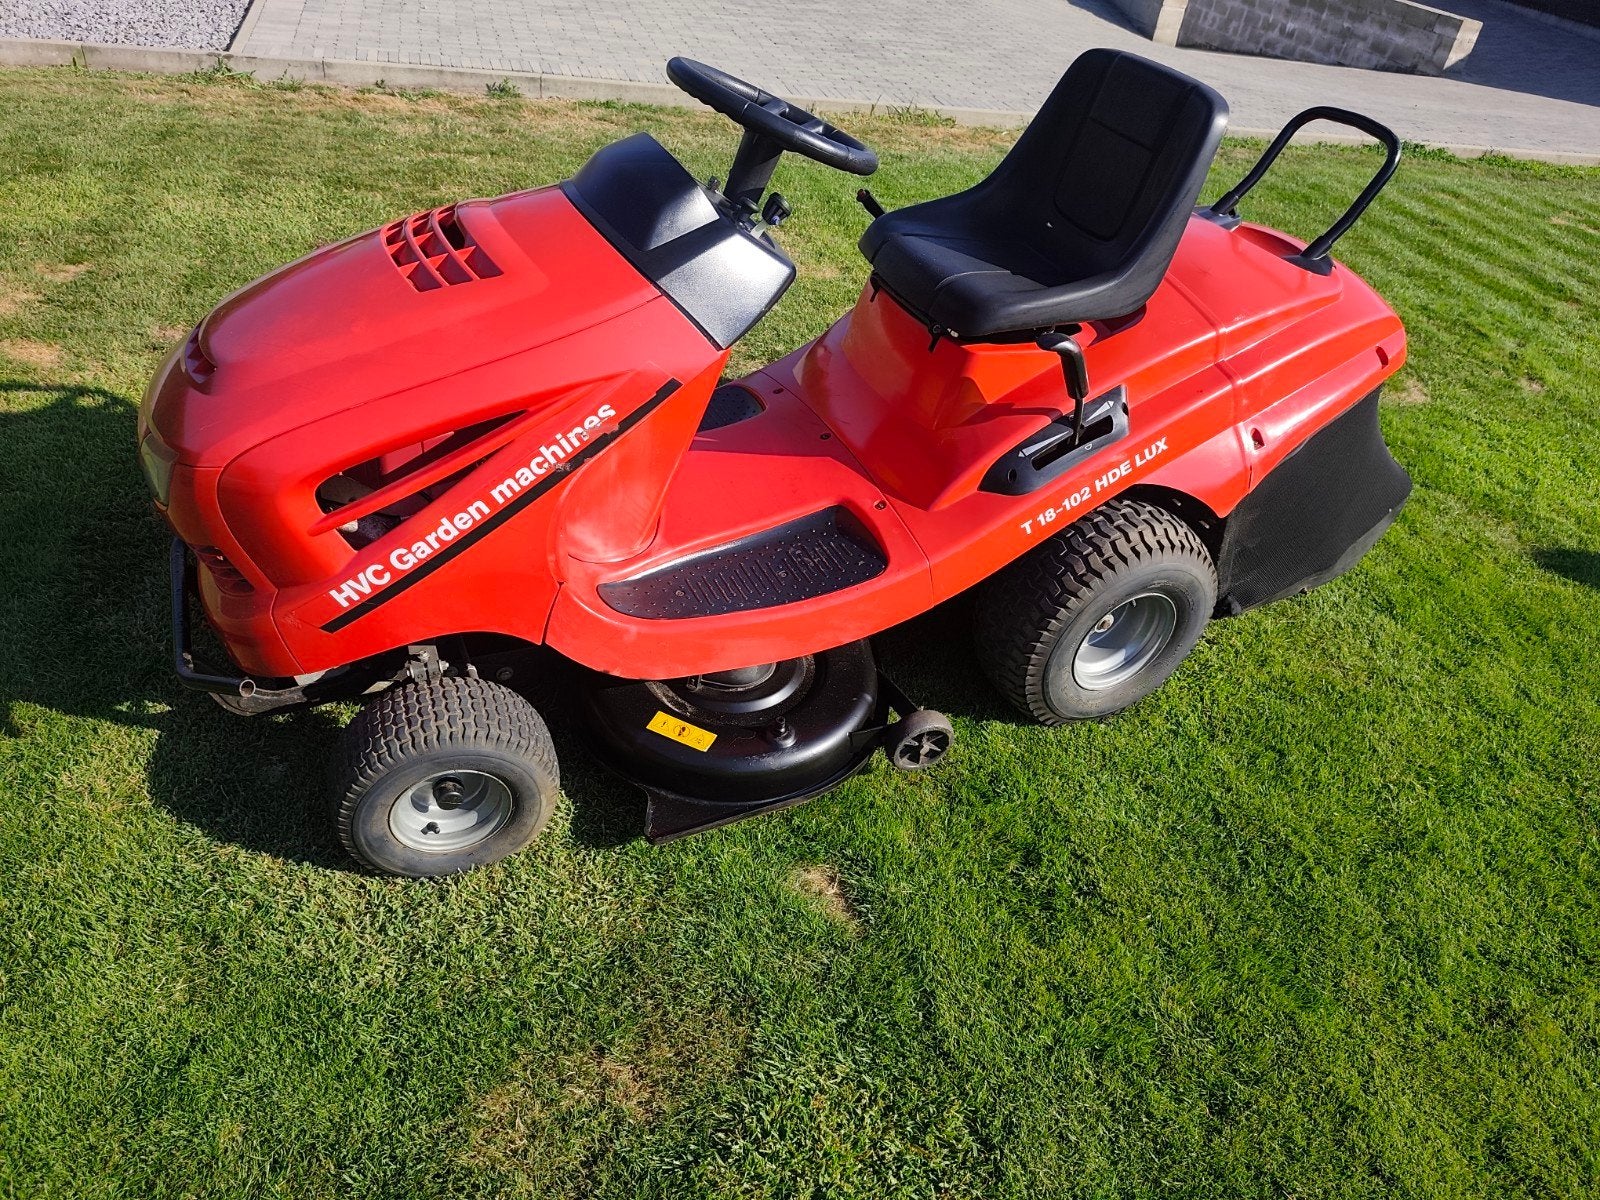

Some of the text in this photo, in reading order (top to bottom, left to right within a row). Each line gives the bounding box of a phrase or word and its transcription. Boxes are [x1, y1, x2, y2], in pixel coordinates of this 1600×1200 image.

[328, 402, 617, 608] HVC Garden machines
[1020, 436, 1169, 535] T 18-102 HDE LUX
